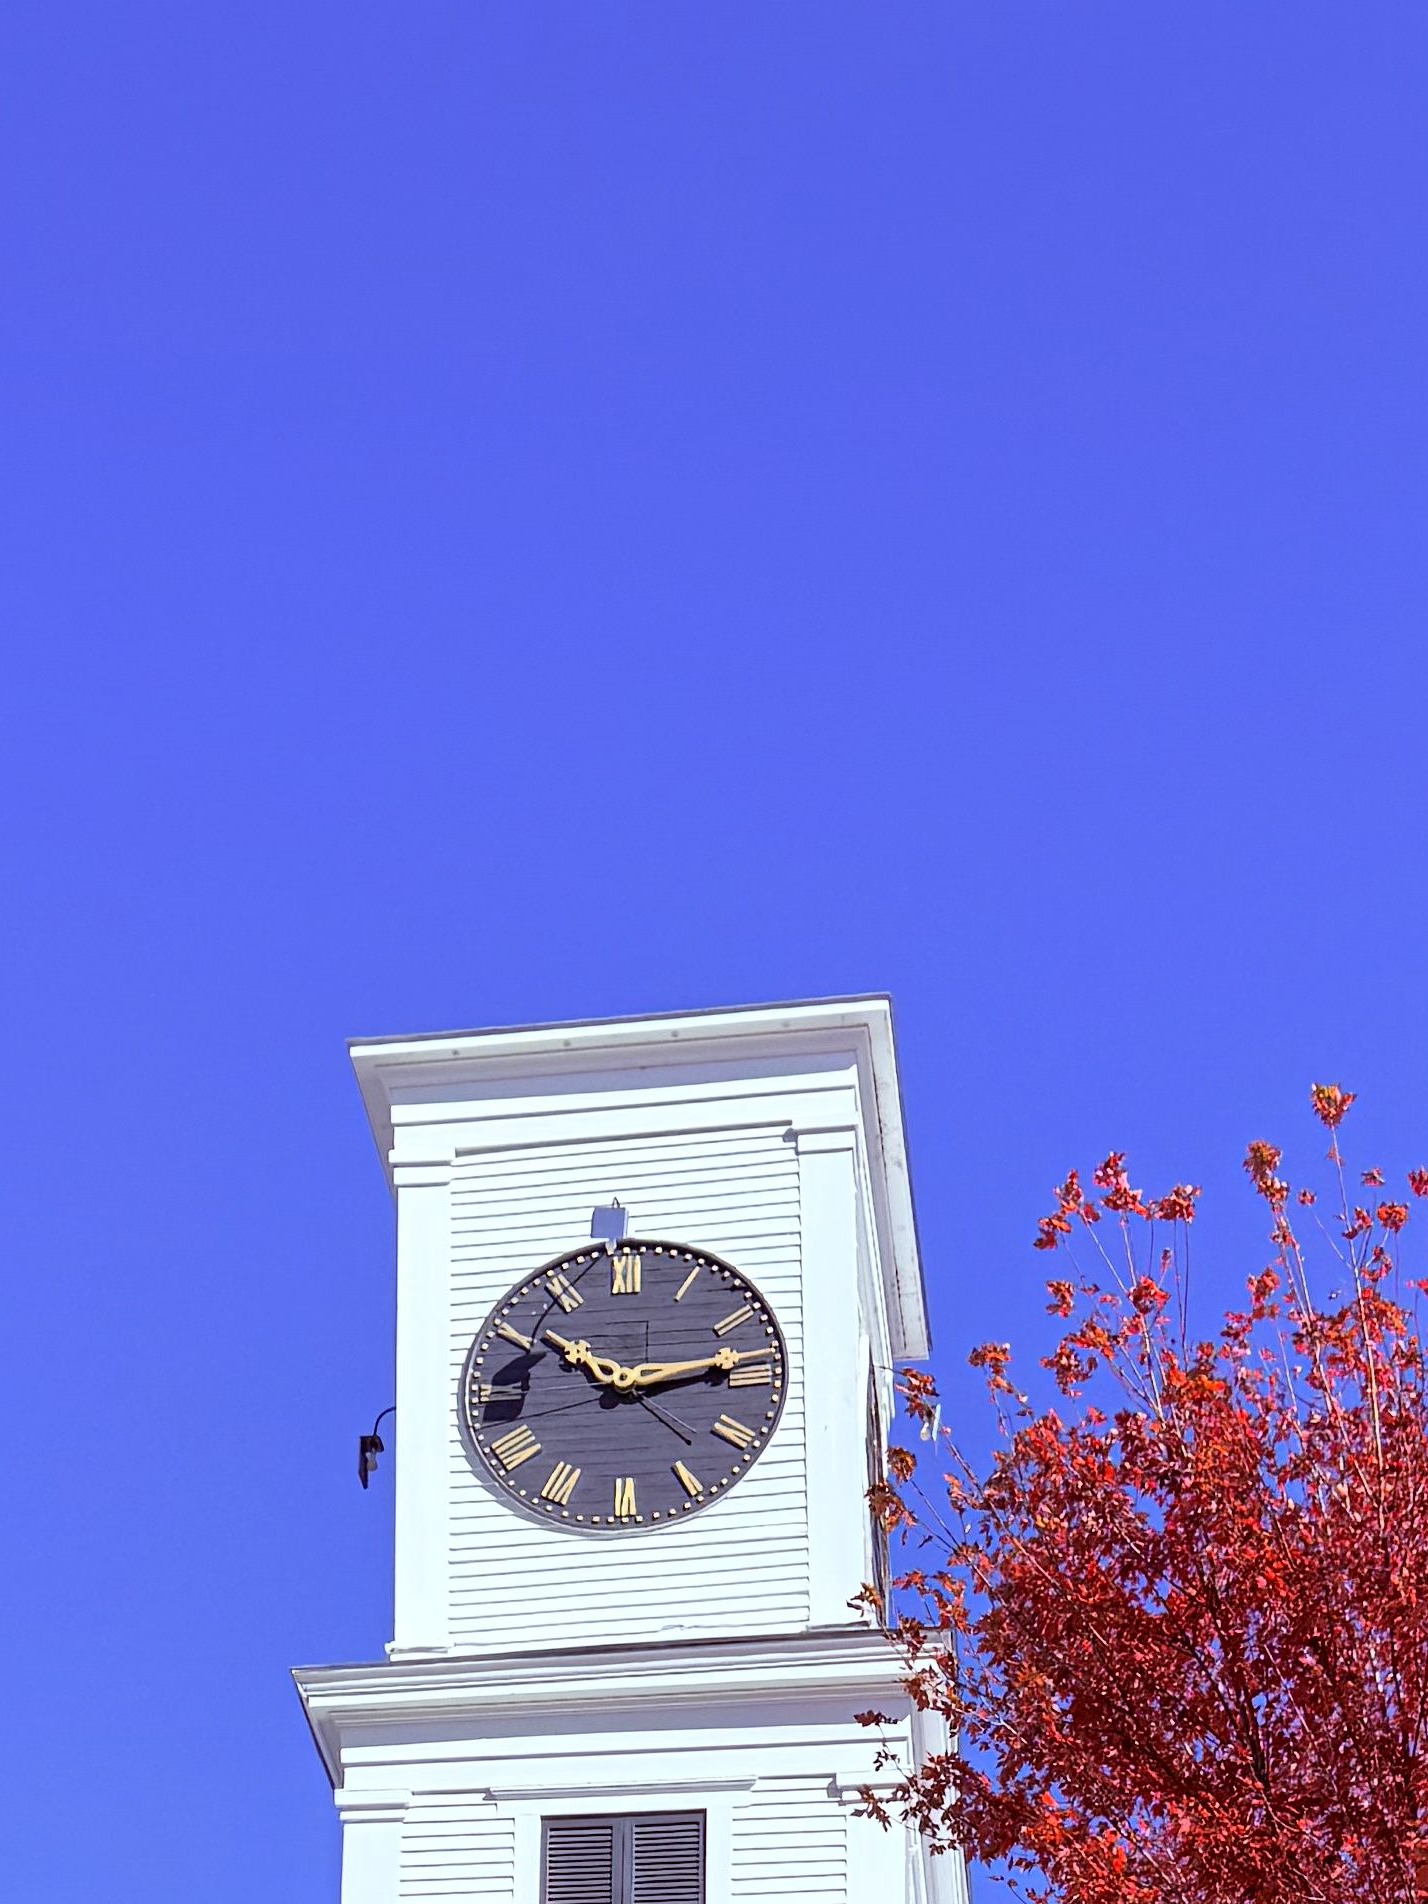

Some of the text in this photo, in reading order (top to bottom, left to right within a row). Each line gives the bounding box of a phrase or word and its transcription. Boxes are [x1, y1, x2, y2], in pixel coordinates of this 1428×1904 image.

[545, 1273, 584, 1314] XI
[611, 1255, 641, 1295] XII
[496, 1320, 534, 1351] X
[713, 1304, 755, 1336] II
[728, 1364, 773, 1387] III
[491, 1424, 543, 1471] VIII
[540, 1460, 582, 1506] VII
[613, 1476, 637, 1518] VI
[672, 1460, 704, 1497] V
